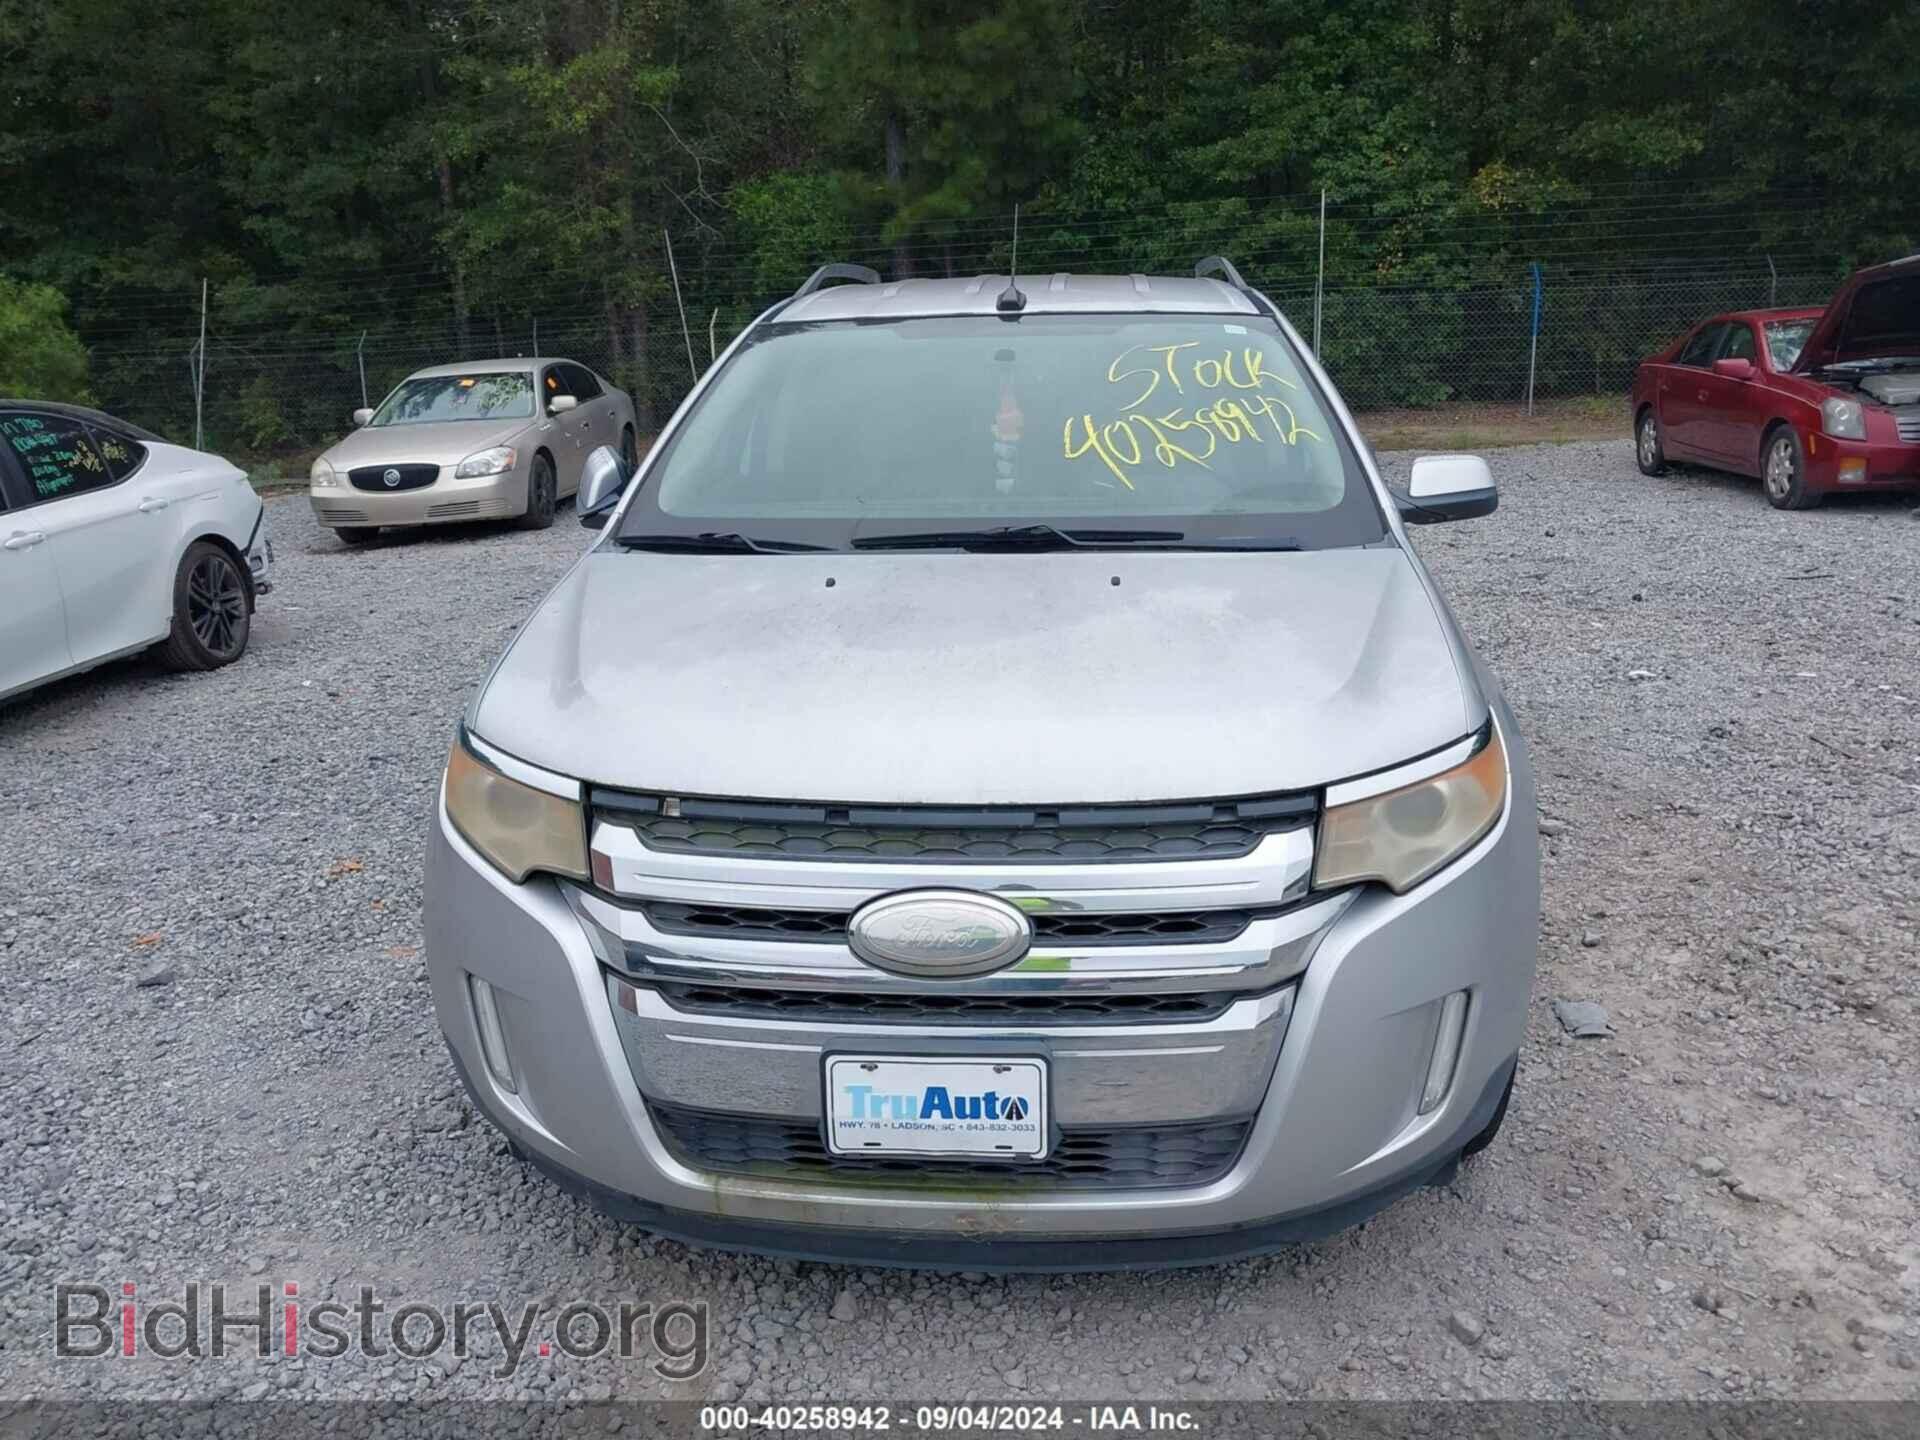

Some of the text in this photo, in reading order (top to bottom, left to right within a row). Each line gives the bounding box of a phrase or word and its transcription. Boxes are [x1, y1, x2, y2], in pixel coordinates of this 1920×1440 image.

[1064, 395, 1321, 490] 40258942
[896, 915, 979, 949] Ford
[844, 1085, 1029, 1120] TruAuto
